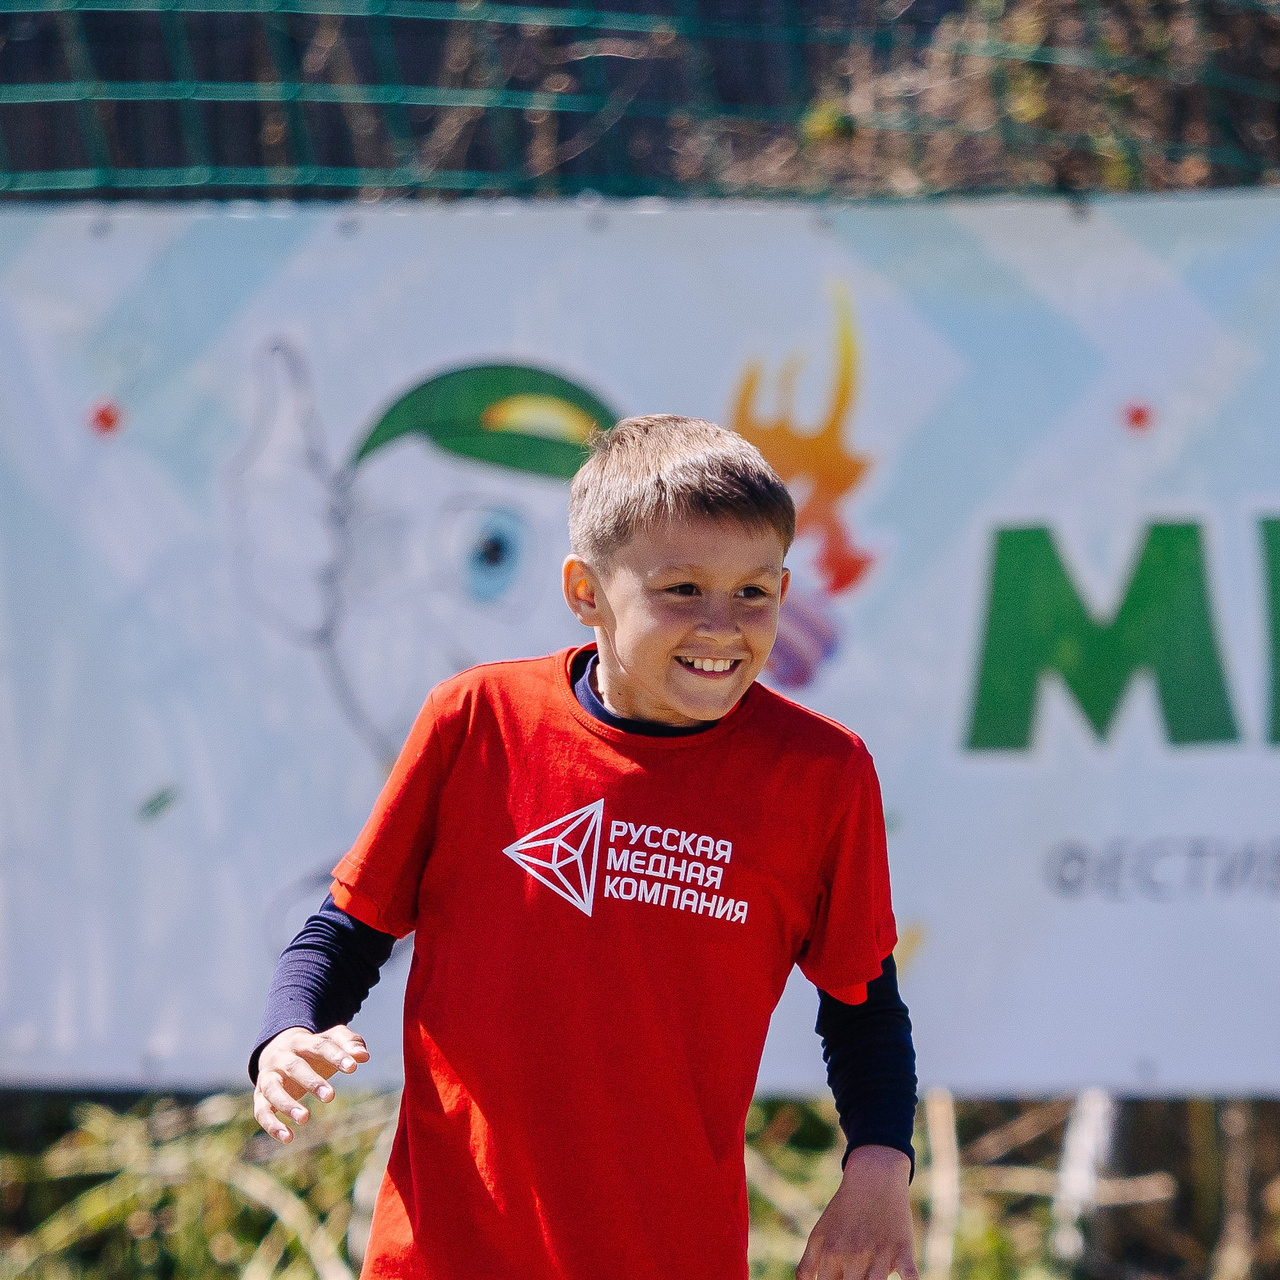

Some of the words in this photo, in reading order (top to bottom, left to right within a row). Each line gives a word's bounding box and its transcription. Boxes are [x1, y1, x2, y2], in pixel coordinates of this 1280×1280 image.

[609, 820, 733, 864] РУССКАЯ
[606, 848, 724, 890] МЕДНАЯ
[603, 875, 749, 924] КОМПАНИЯ
